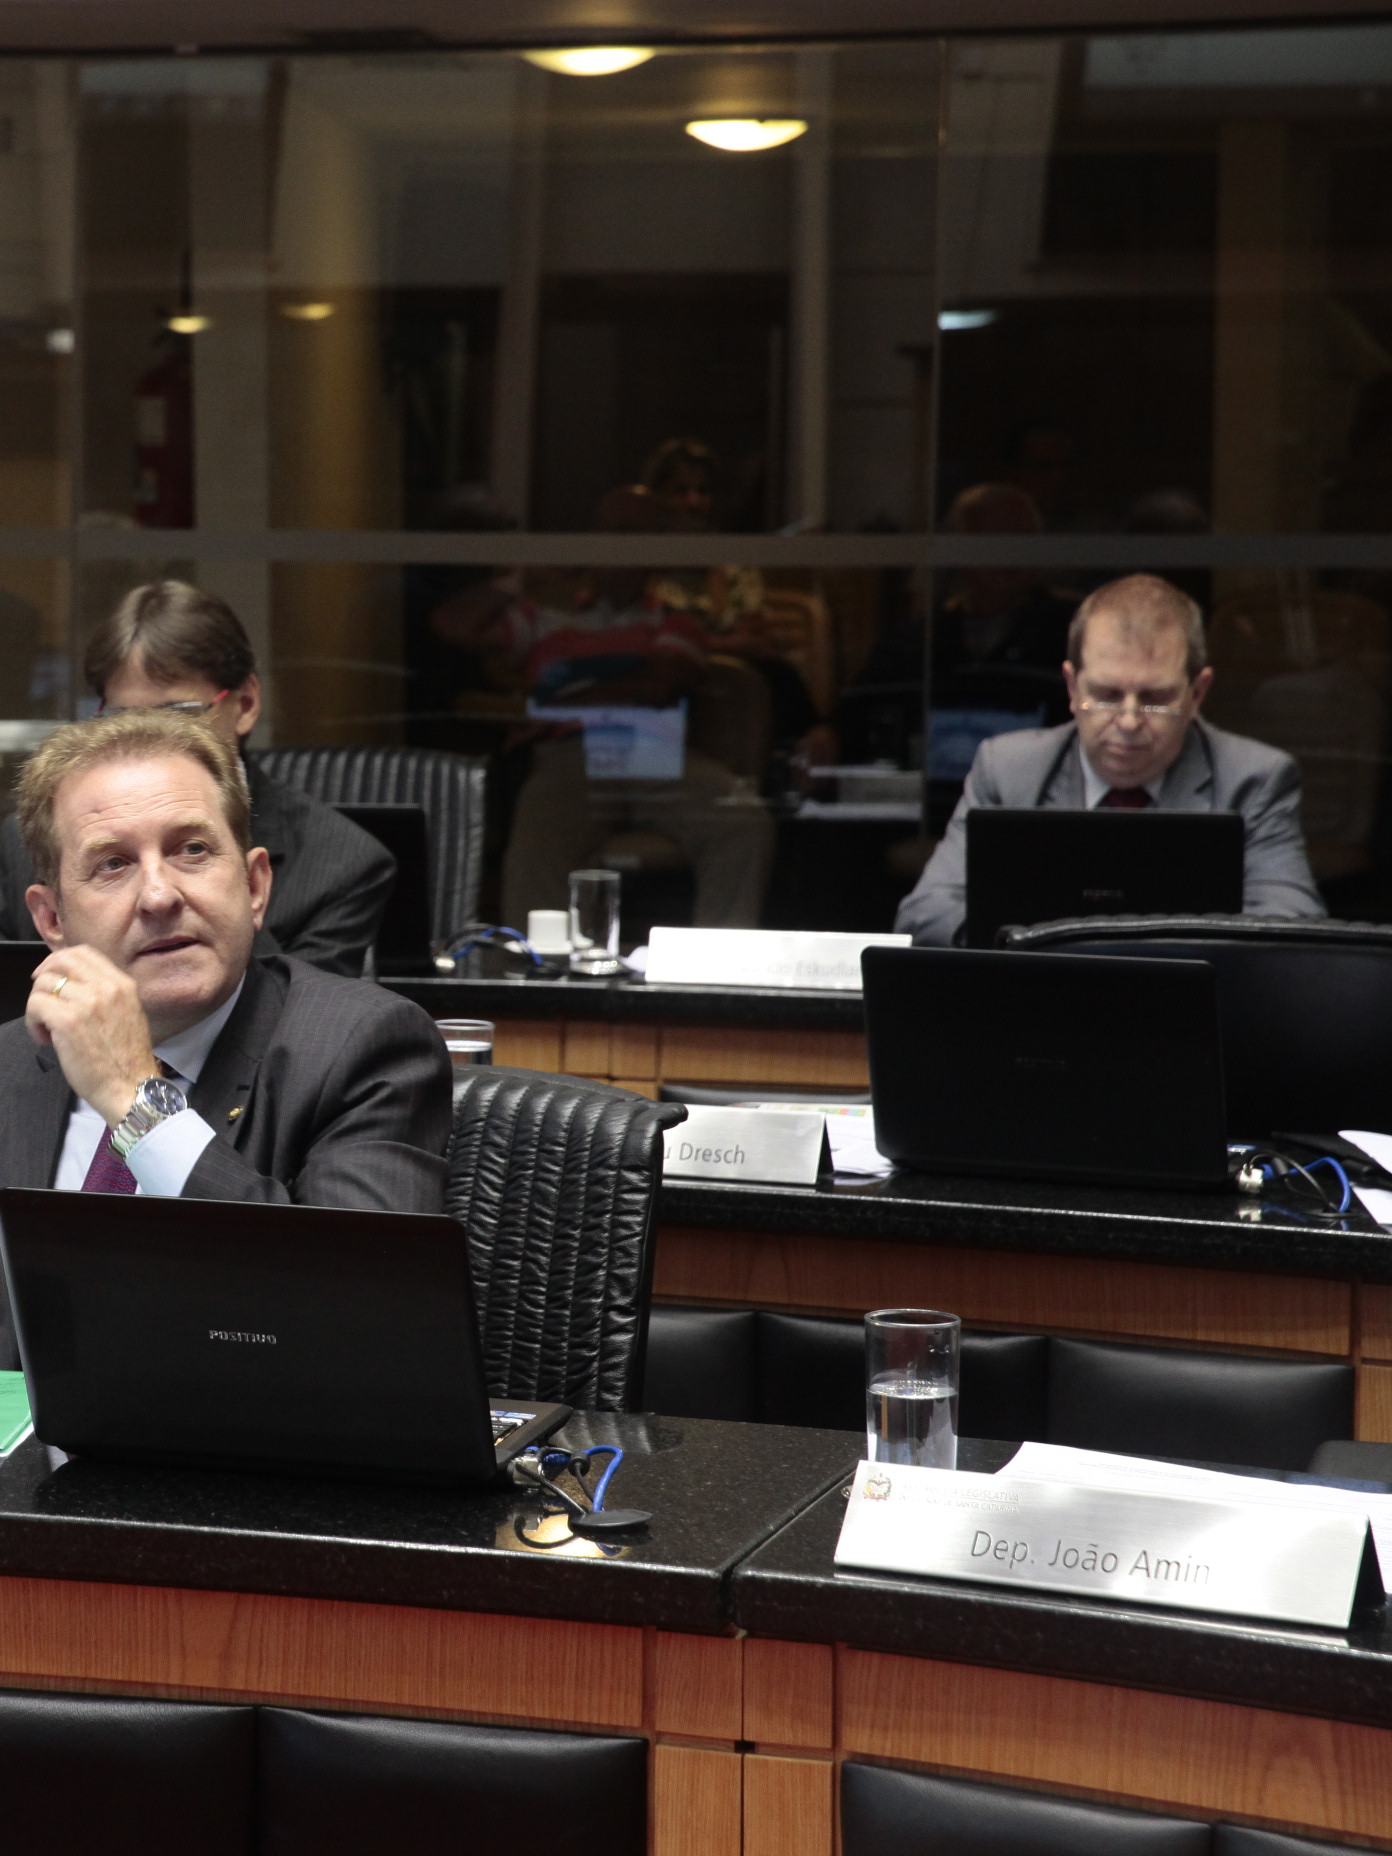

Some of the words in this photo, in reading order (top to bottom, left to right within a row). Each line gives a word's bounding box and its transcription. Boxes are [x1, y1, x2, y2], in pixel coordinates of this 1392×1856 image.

[679, 1142, 745, 1165] Dresch
[209, 1329, 277, 1344] POSITIVO
[971, 1530, 1035, 1569] Dep.
[1048, 1539, 1119, 1574] João
[1128, 1549, 1210, 1585] Amin
